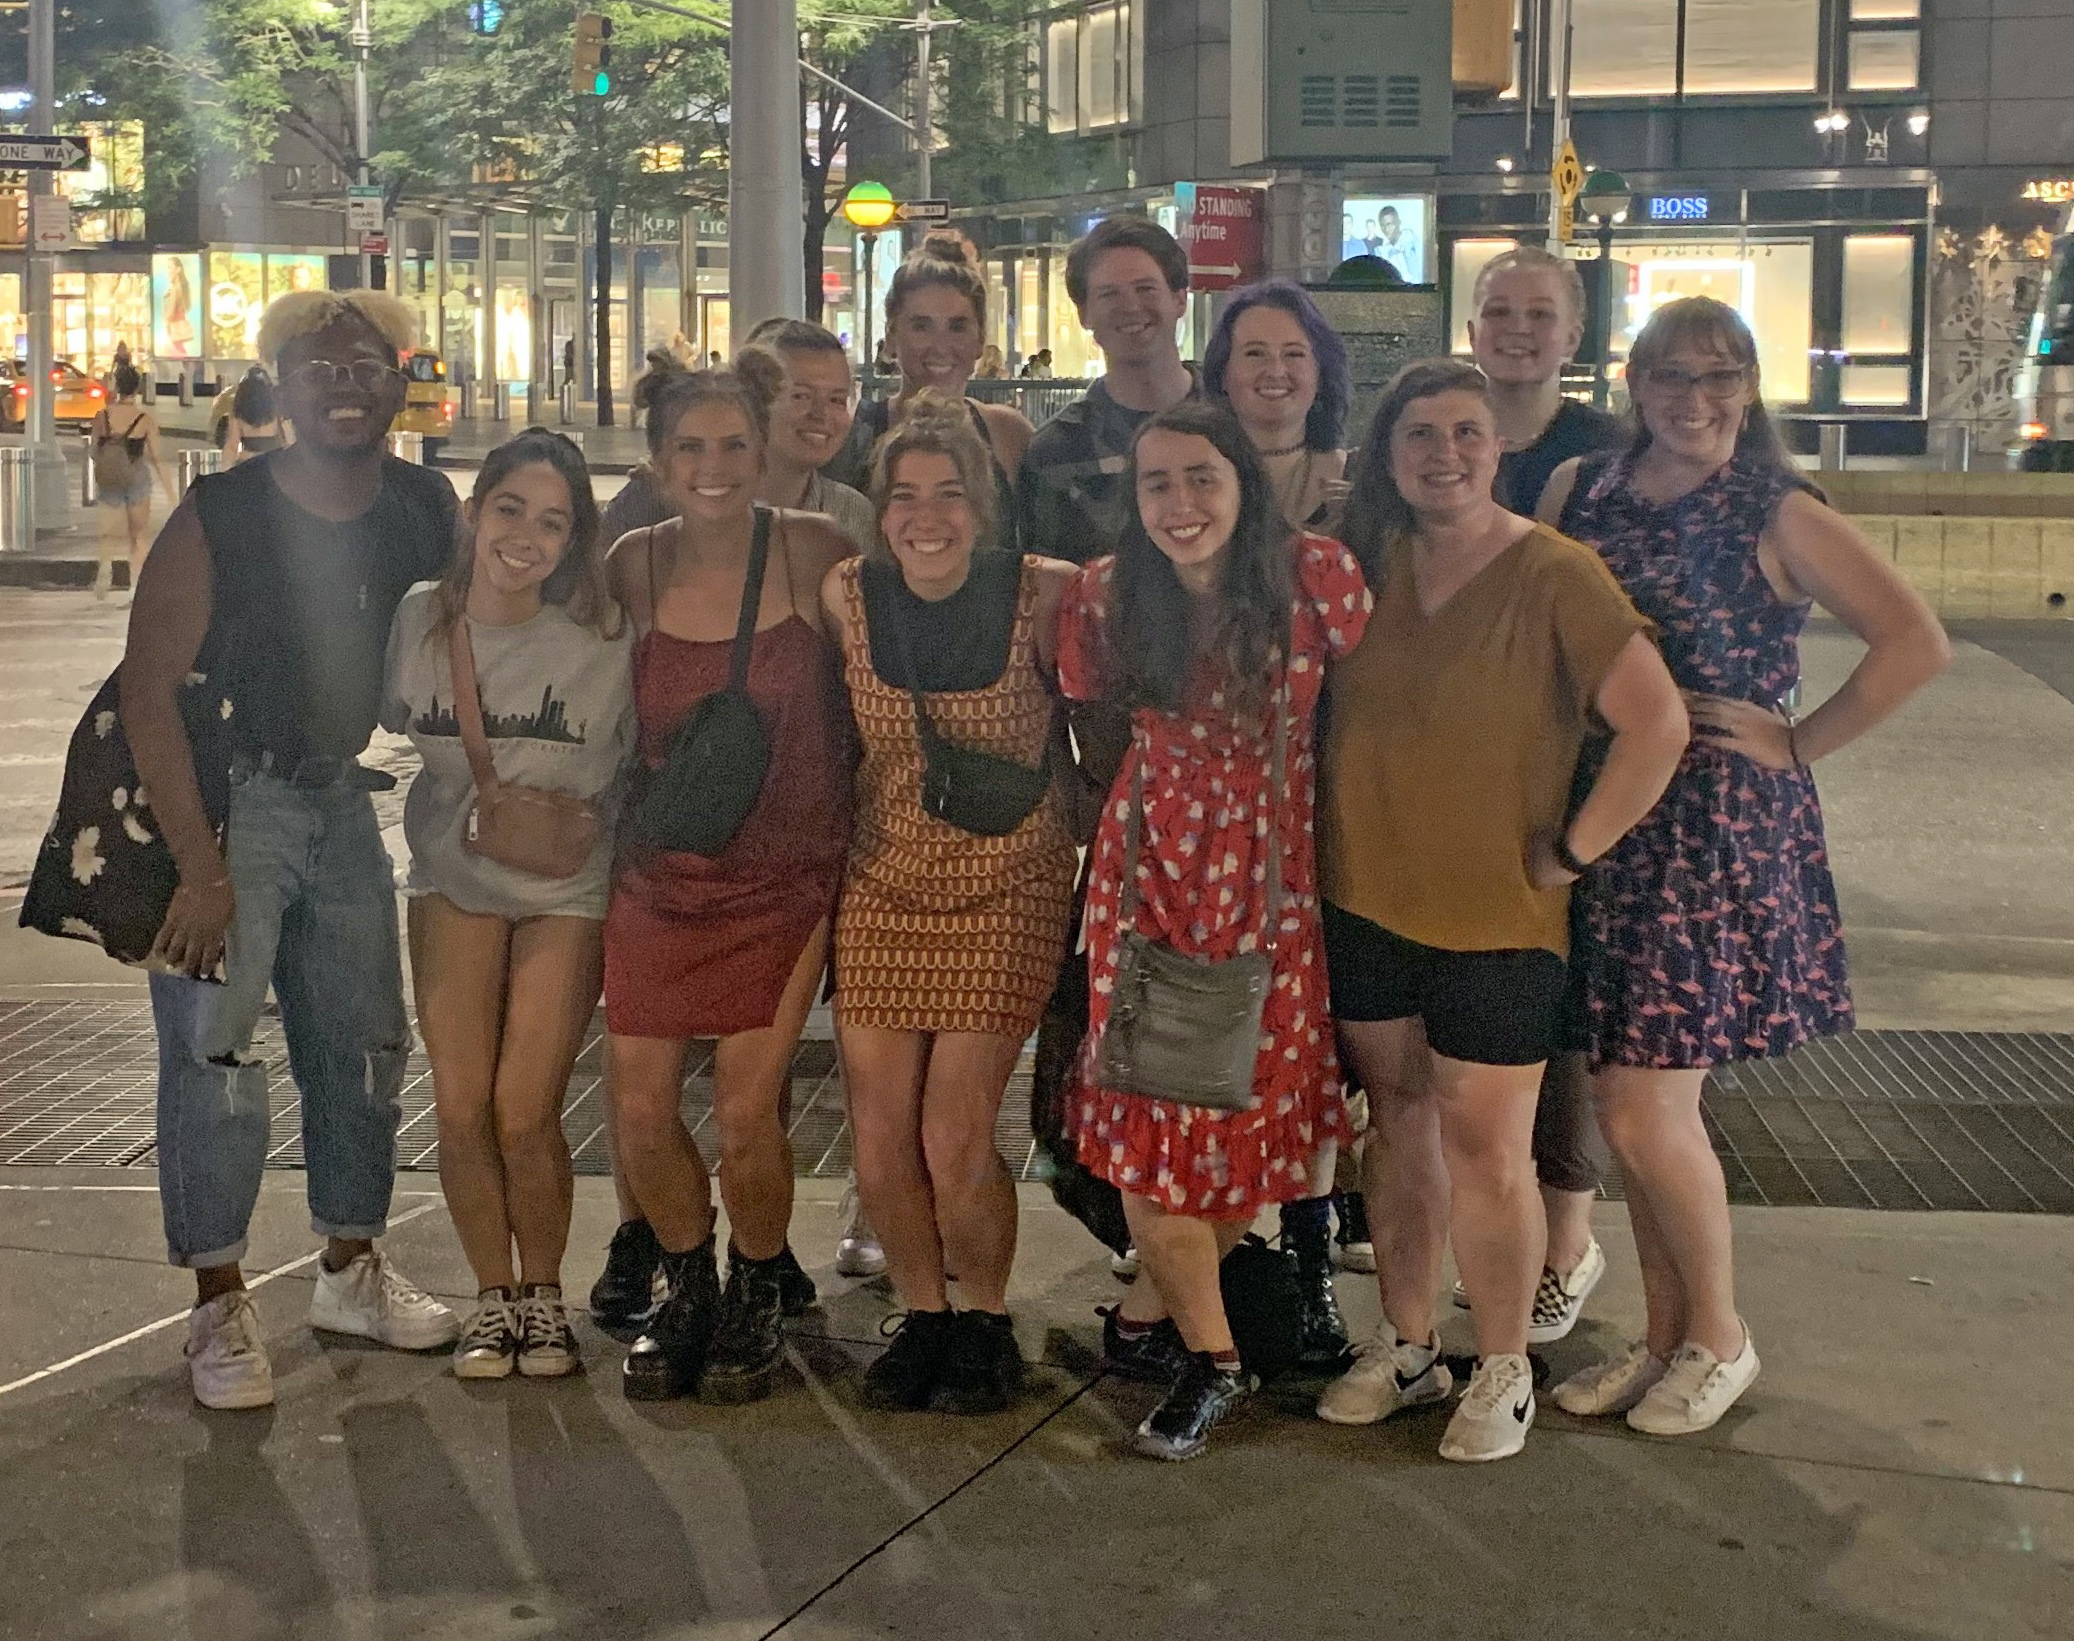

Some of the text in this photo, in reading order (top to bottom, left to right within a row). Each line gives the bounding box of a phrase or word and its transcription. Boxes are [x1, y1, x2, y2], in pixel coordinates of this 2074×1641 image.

[0, 146, 75, 160] ONE WAY
[1199, 196, 1252, 217] STANDING
[1651, 197, 1708, 215] BOSS
[1180, 220, 1227, 243] Anytime
